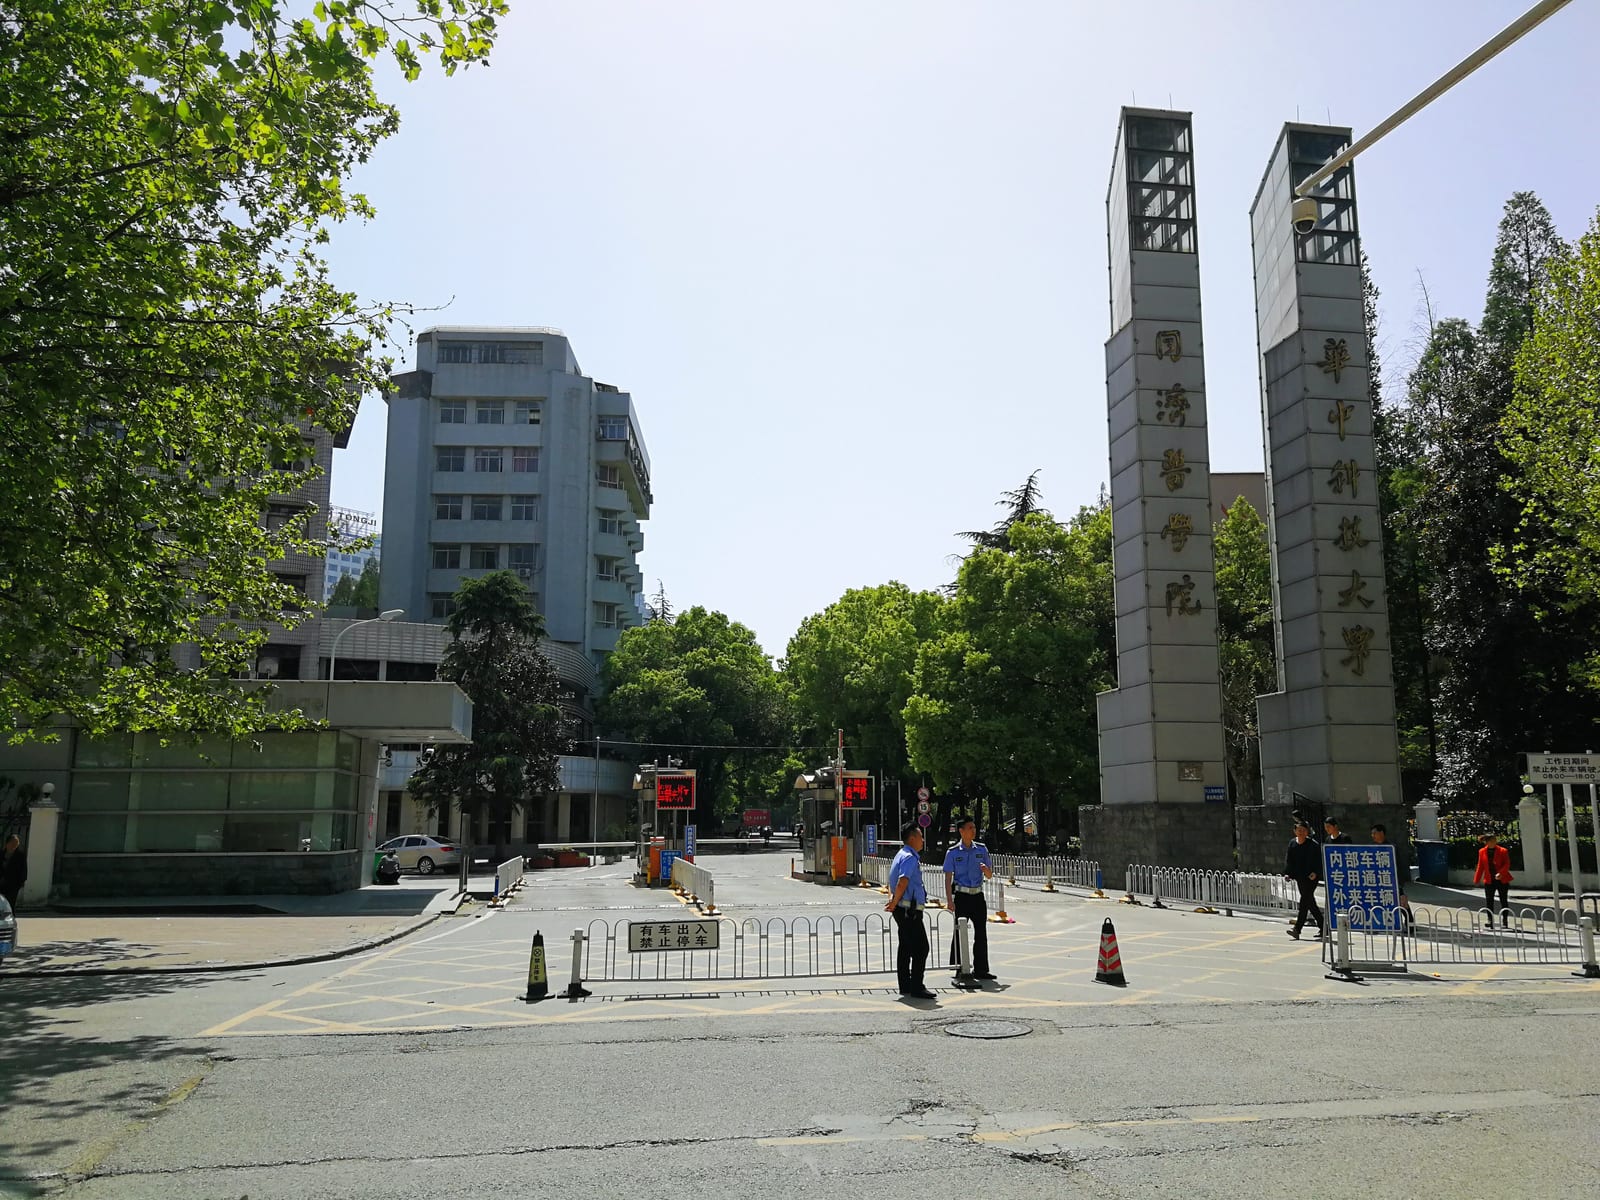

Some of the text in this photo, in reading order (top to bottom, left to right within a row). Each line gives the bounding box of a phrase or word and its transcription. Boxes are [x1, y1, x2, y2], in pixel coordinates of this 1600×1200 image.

[338, 512, 376, 526] TONGJI
[1545, 757, 1589, 765] 工作日期间
[1330, 851, 1391, 868] 内部车辆
[1331, 869, 1393, 887] 专用通道
[1333, 889, 1394, 906] 外来车辆
[640, 924, 708, 936] 有车出入
[640, 935, 708, 948] 禁止停车
